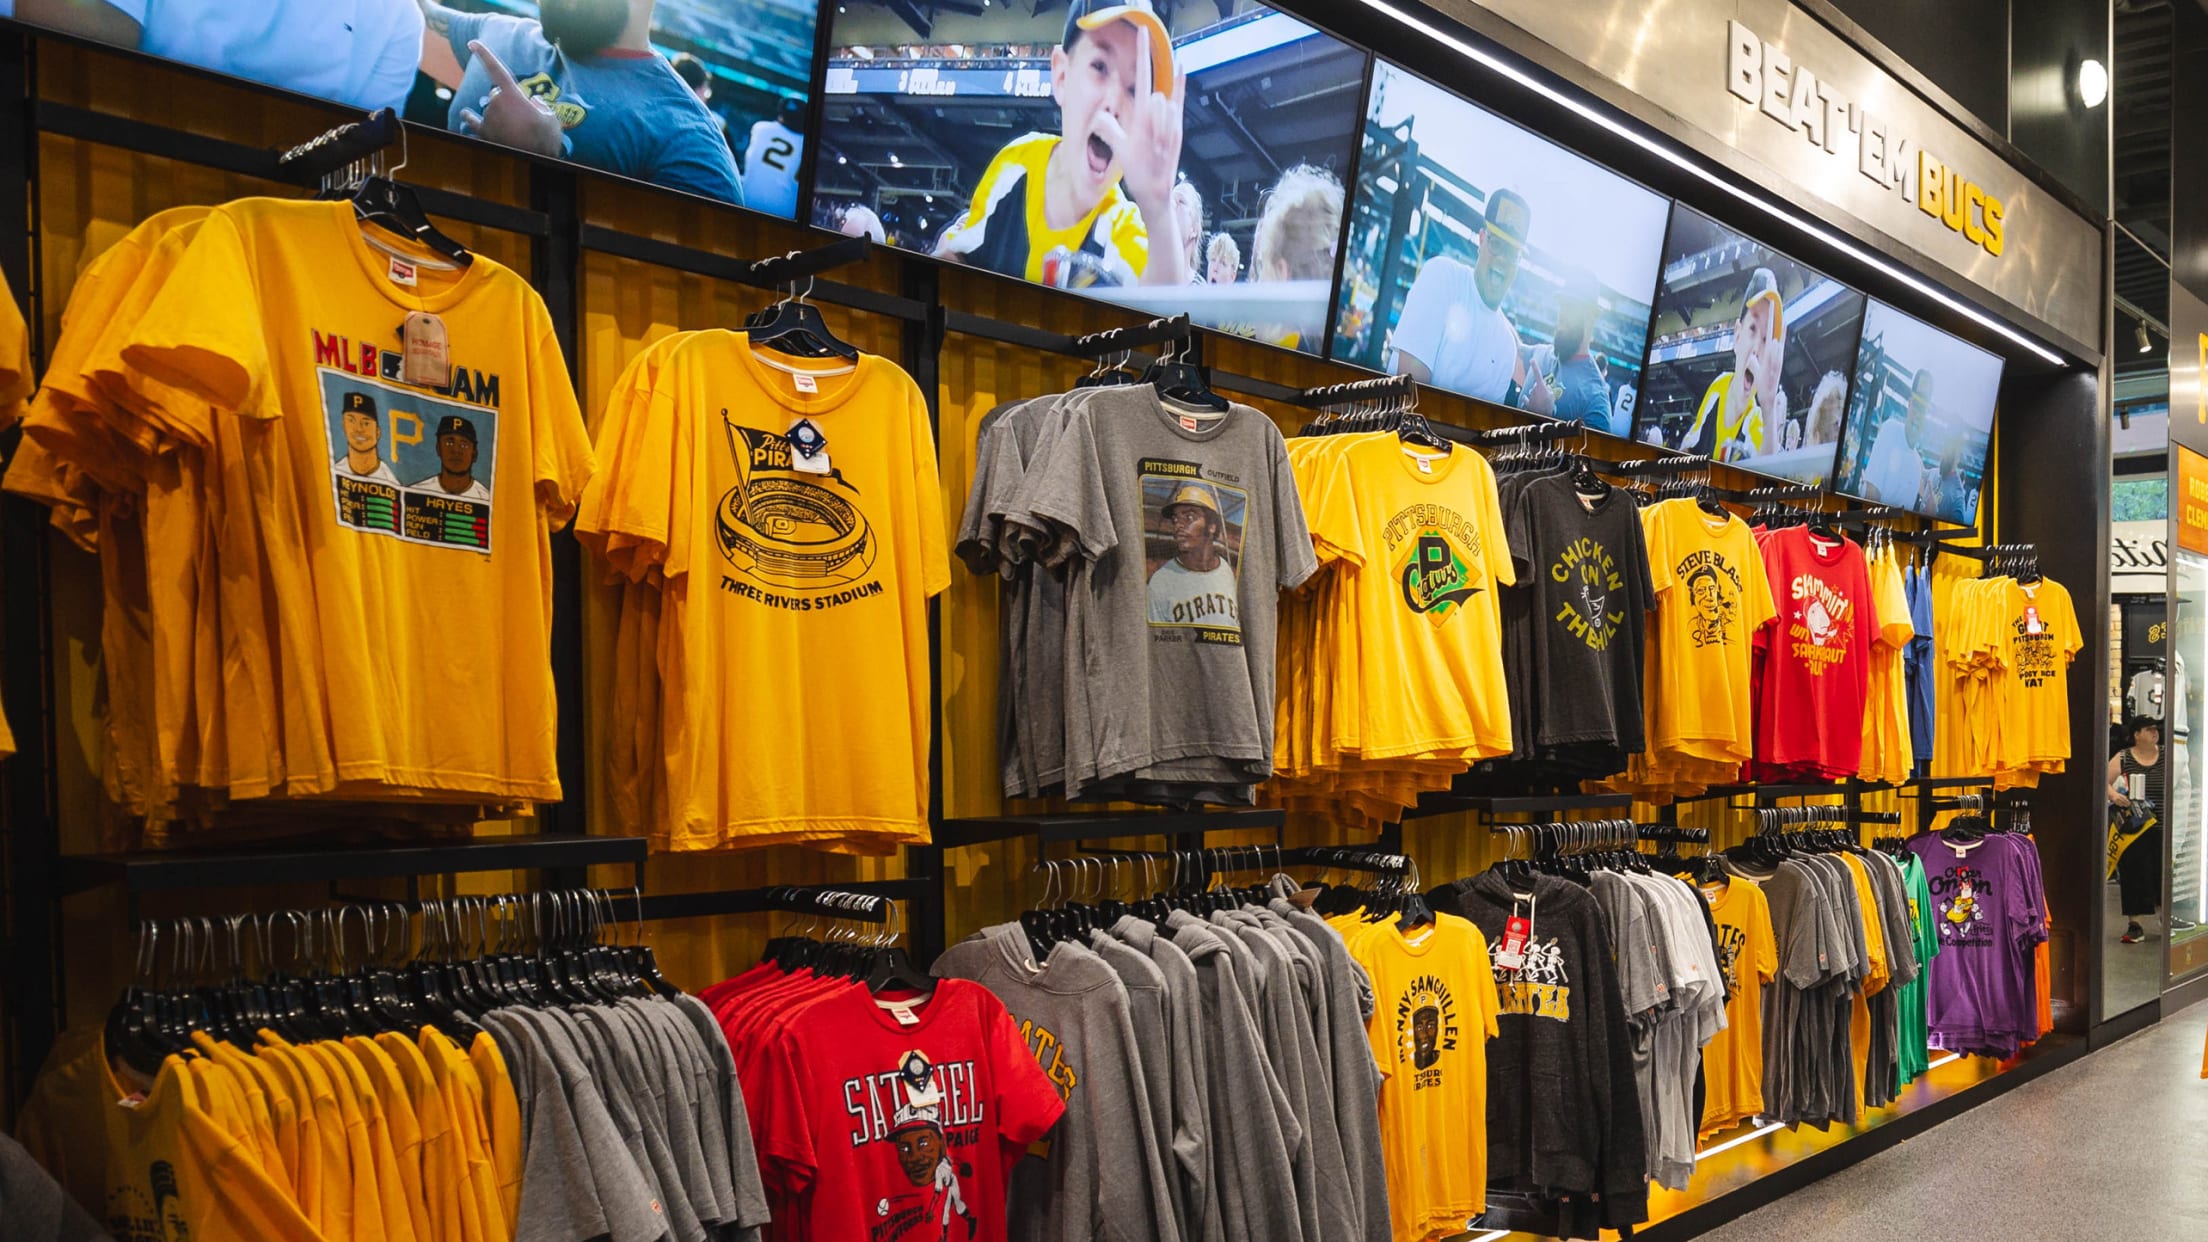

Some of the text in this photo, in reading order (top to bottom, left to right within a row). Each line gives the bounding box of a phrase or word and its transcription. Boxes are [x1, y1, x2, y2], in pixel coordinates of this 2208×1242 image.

[763, 137, 793, 171] 2
[1728, 19, 1845, 155] BEAT
[1918, 150, 2004, 256] BUCS
[311, 327, 378, 377] MLB
[388, 408, 424, 463] P
[1144, 461, 1240, 483] PITTSBURGH OUTFIELD
[405, 513, 439, 525] POWER
[426, 497, 473, 514] HAYES
[1382, 503, 1481, 558] PITTSBURGH
[1551, 537, 1624, 592] CHICKEN
[1676, 550, 1712, 580] STEVE
[720, 575, 884, 611] THREE RIVERS STADIUM
[1202, 631, 1241, 644] PIRATES
[1410, 974, 1459, 1051] SANGUILLEN
[844, 1060, 984, 1147] SATHEL
